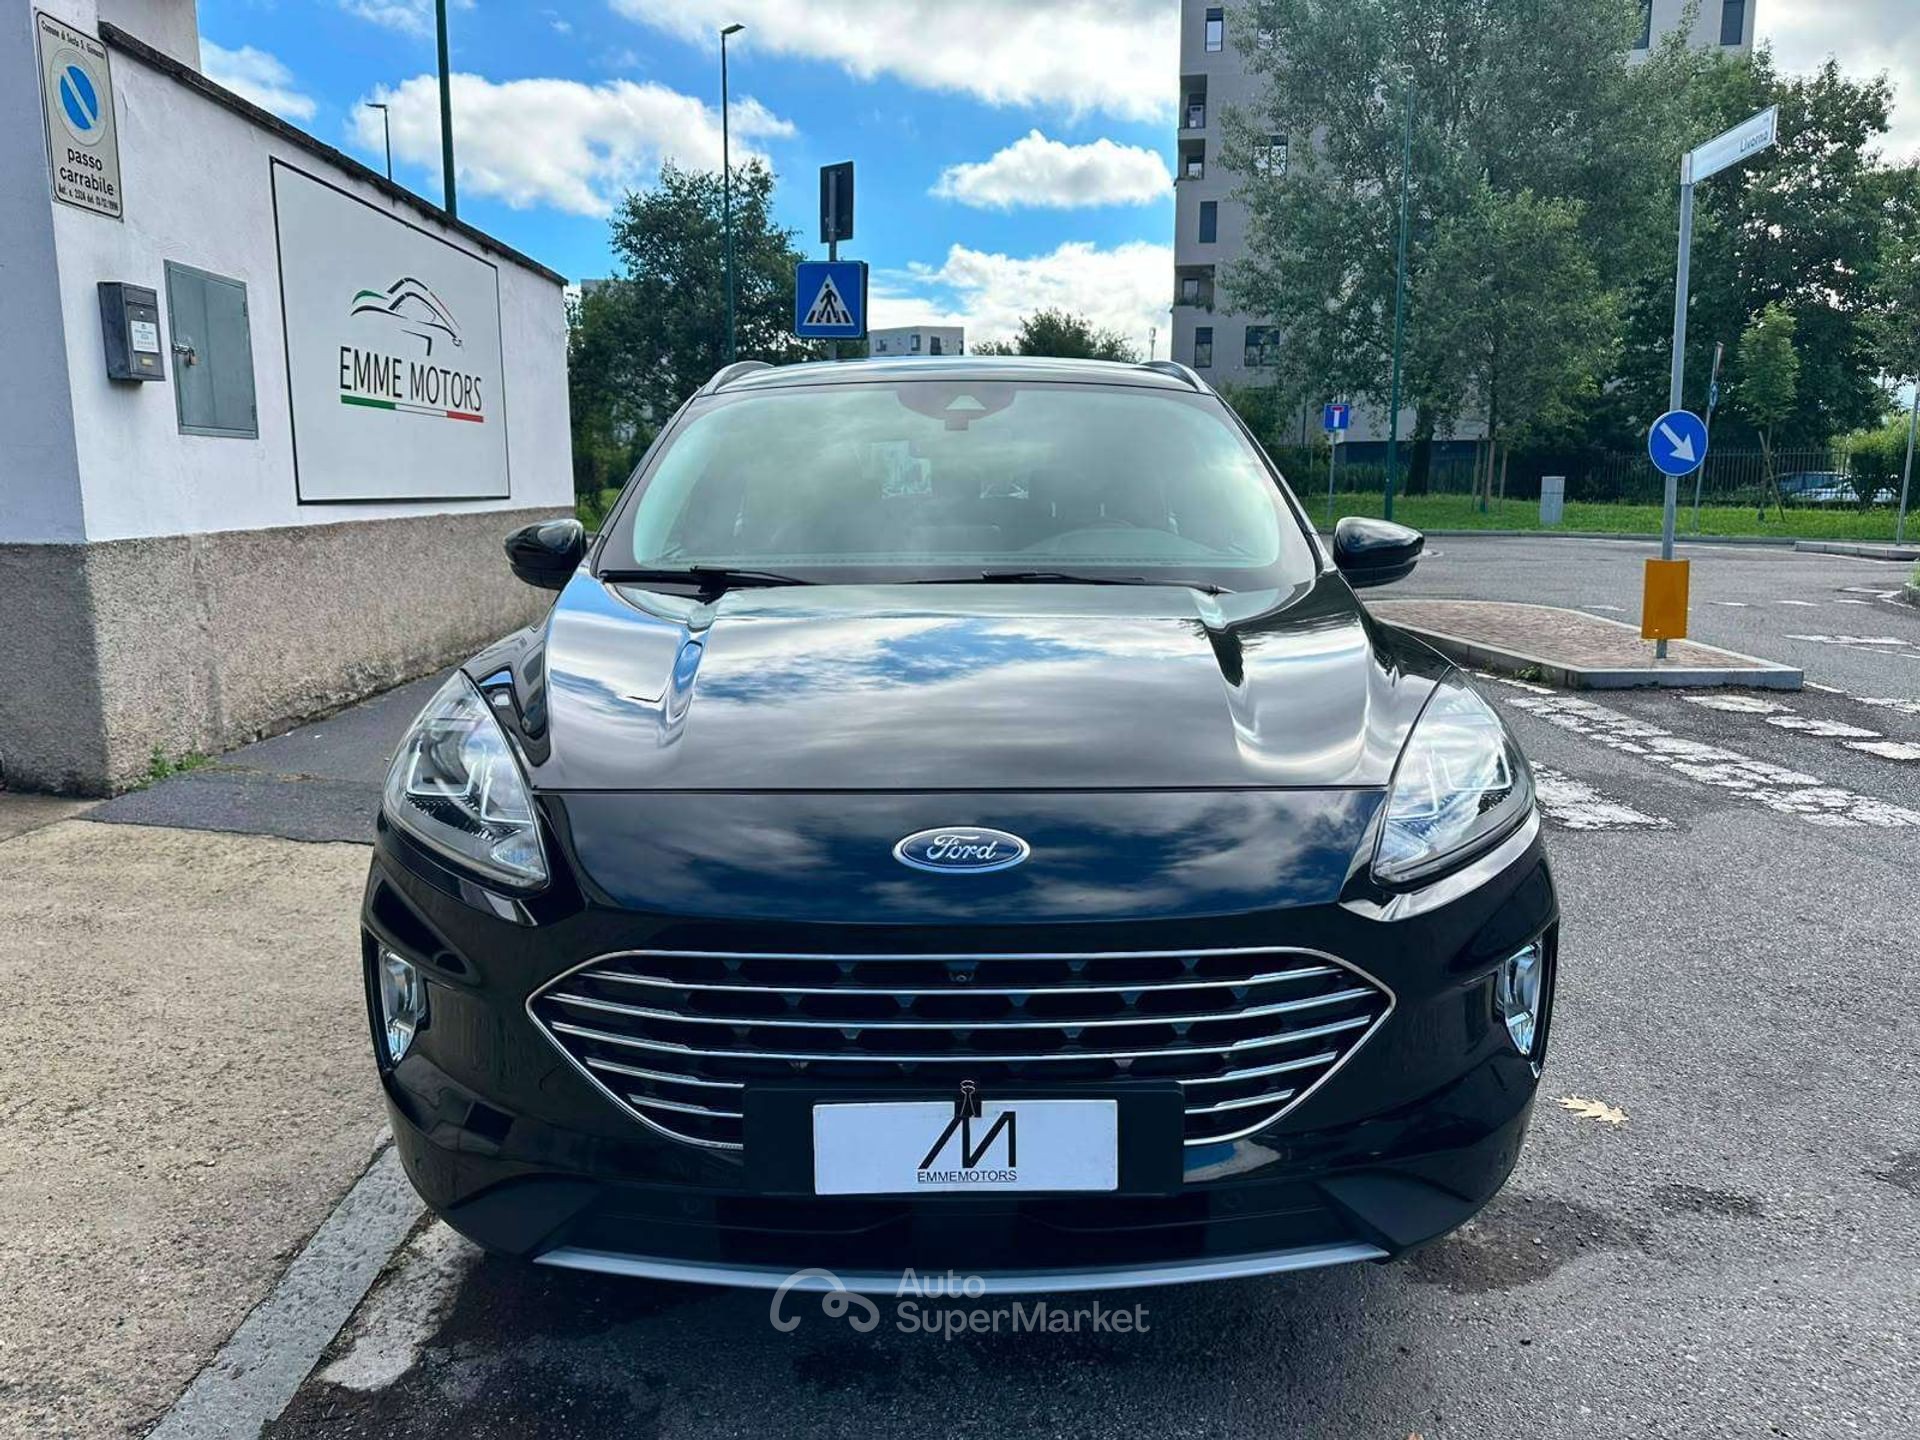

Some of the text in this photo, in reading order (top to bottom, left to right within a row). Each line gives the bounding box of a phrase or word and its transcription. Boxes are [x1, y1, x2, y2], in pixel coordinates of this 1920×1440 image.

[67, 147, 102, 171] passo
[60, 166, 114, 196] carrabile
[340, 346, 482, 412] EMME MOTORS
[926, 834, 998, 860] Ford
[917, 1170, 1018, 1183] EMMEMOTORS
